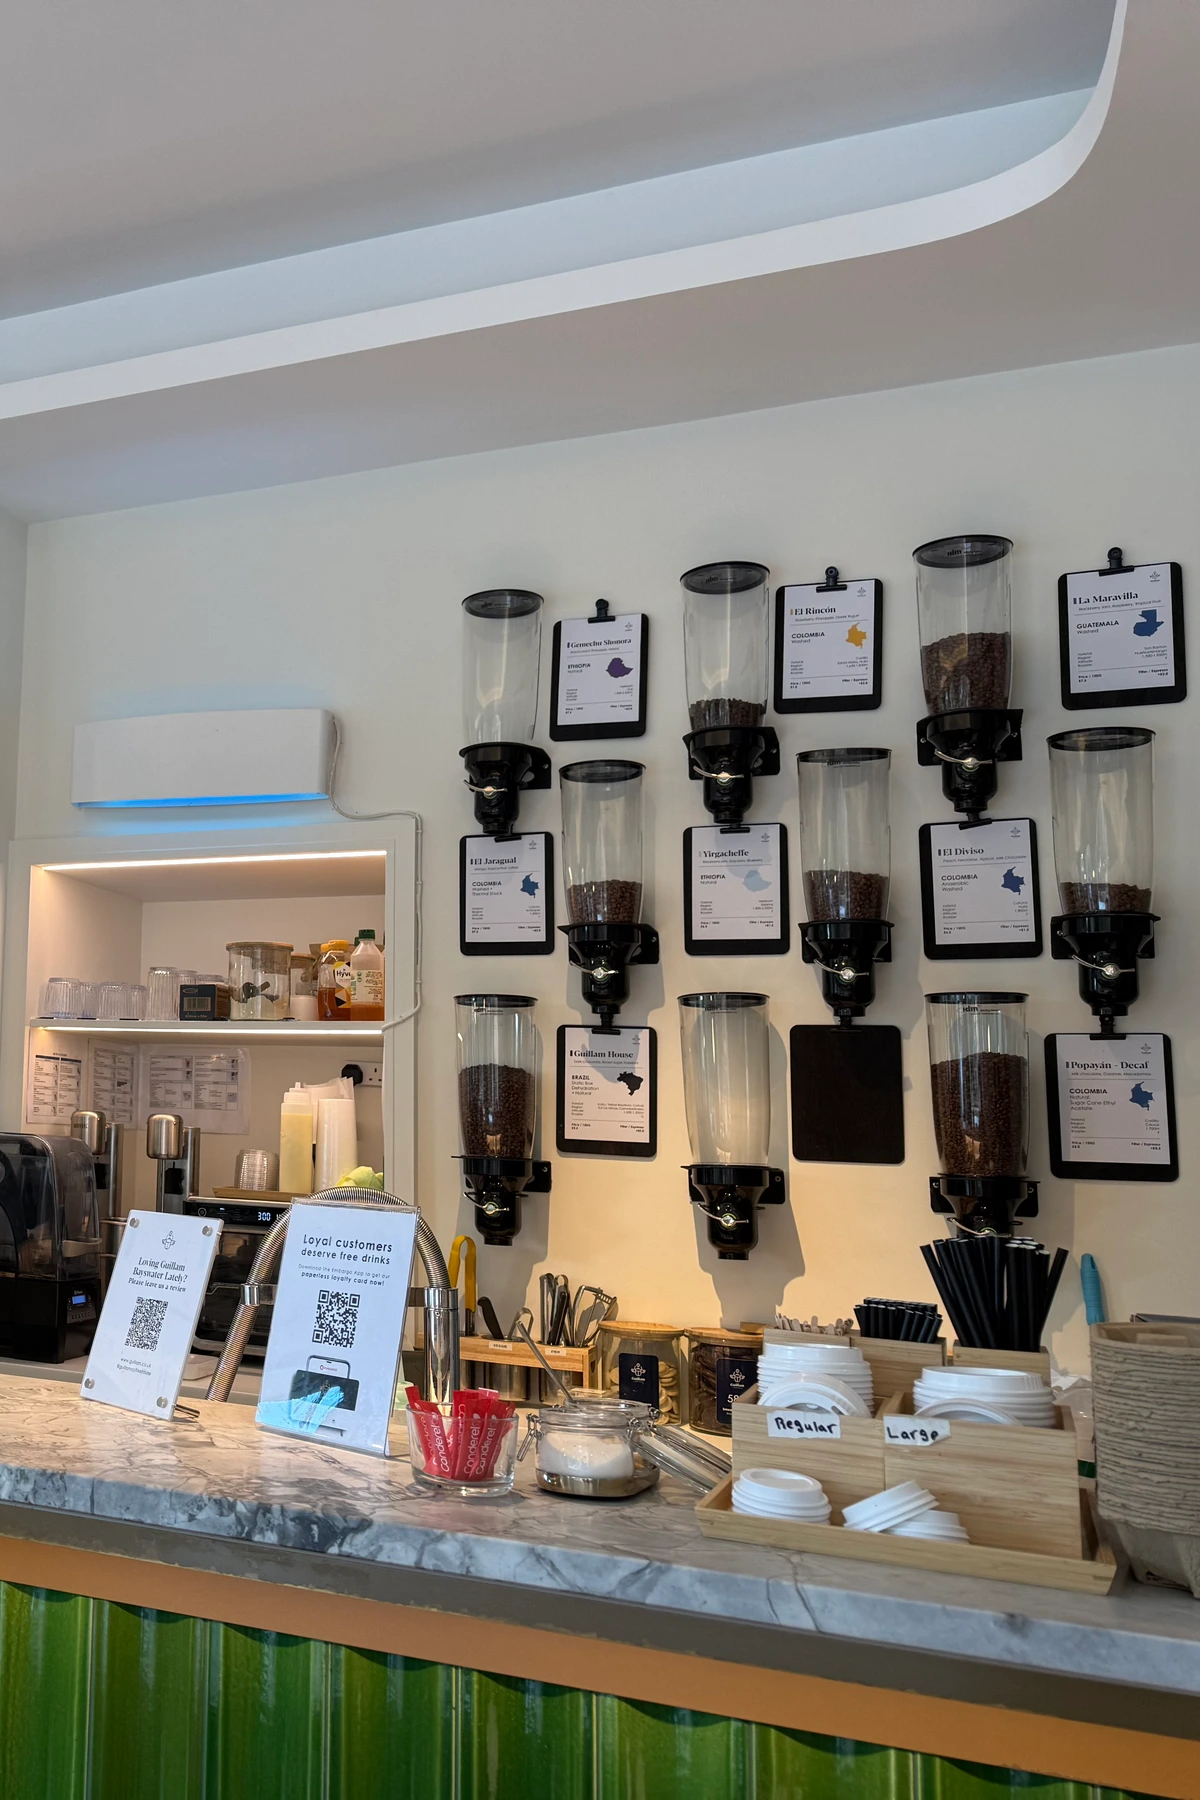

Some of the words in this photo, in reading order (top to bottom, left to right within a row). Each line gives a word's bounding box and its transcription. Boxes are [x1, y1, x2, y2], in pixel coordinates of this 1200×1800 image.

[1093, 592, 1138, 603] Maravilla
[806, 606, 836, 615] Rincón
[1077, 620, 1119, 629] GUATEMALA
[703, 849, 749, 858] Yirgacheffe
[955, 847, 984, 856] Diviso
[574, 1050, 606, 1058] Guillam
[1071, 1061, 1112, 1070] Popayán
[258, 1212, 271, 1221] 300
[303, 1234, 332, 1247] Loyal
[336, 1239, 392, 1253] customers
[301, 1248, 336, 1259] deserve
[340, 1251, 358, 1261] free
[362, 1254, 390, 1265] drinks
[138, 1257, 160, 1269] Loving
[160, 1260, 185, 1271] Guillam
[133, 1267, 164, 1278] Bayswater
[164, 1272, 188, 1284] Lately?
[301, 1271, 329, 1280] paperless
[331, 1274, 352, 1283] loyalty
[128, 1277, 144, 1286] Please
[144, 1280, 157, 1288] leave
[775, 1416, 837, 1434] Regular
[887, 1426, 939, 1442] Large
